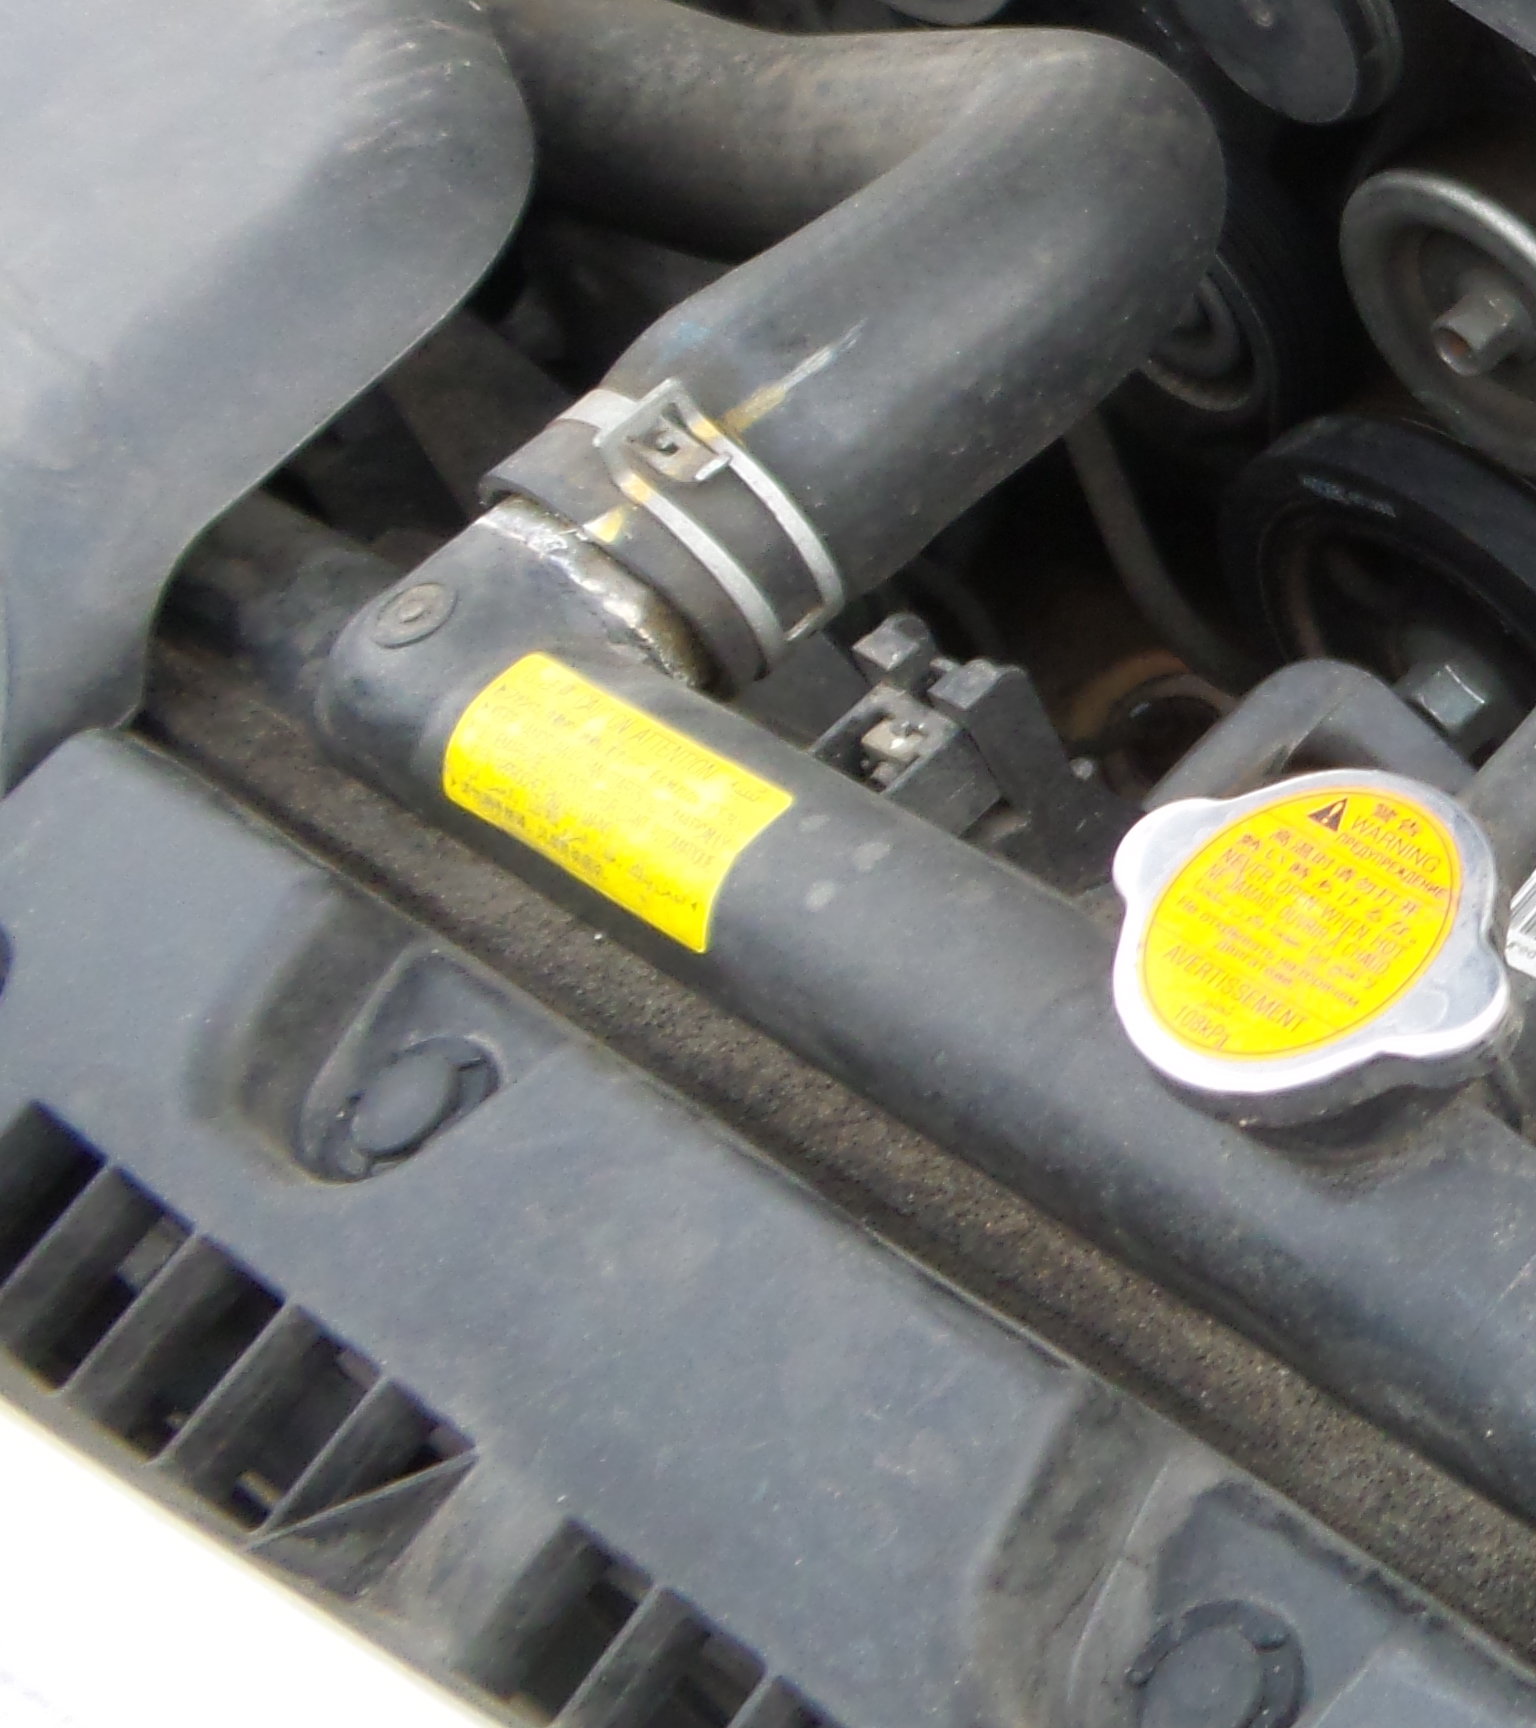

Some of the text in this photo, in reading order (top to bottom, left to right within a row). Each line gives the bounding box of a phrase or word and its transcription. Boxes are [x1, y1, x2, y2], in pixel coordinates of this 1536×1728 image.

[629, 726, 720, 782] ATTENTION
[1334, 831, 1447, 900] ПРЕДУПРЕЖДЕНИЕ
[1349, 814, 1443, 874] WARNING
[1220, 846, 1275, 887] NEVER
[1274, 877, 1321, 910] OPEN
[1319, 903, 1371, 943] WHEN
[1370, 933, 1408, 961] HOT
[1161, 944, 1309, 1034] AVERTISSEMENT
